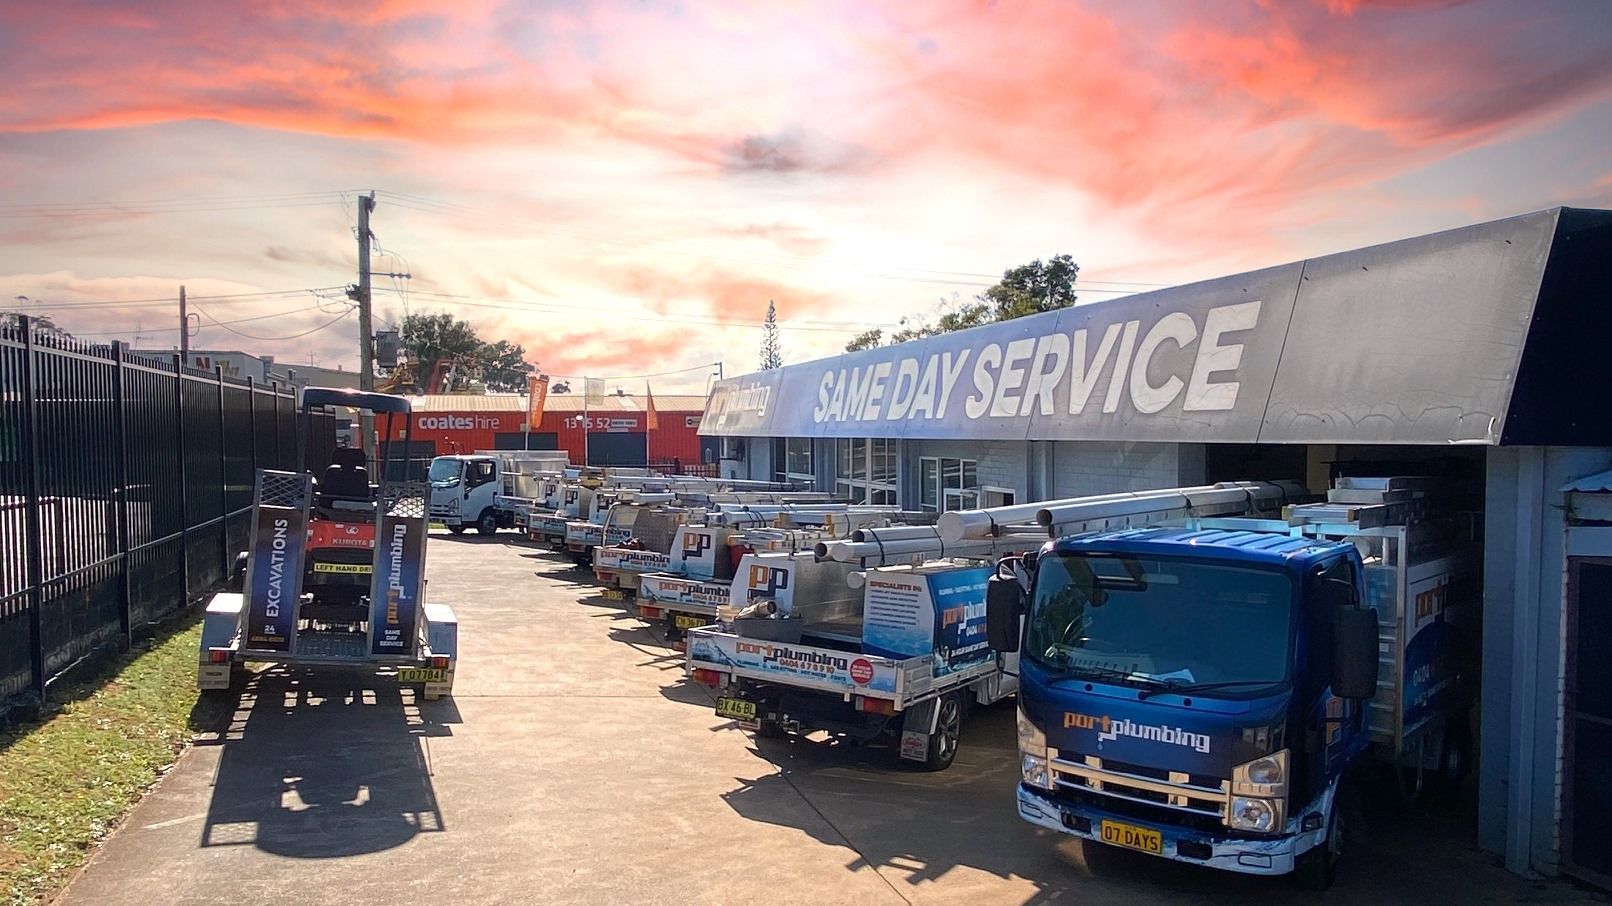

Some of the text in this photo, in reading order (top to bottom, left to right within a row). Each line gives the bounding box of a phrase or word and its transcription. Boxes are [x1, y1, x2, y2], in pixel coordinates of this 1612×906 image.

[813, 300, 1262, 424] SAME DAY SERVICE
[563, 417, 577, 429] 13
[596, 417, 610, 429] 52
[332, 538, 367, 546] KUBOTA
[266, 519, 288, 617] EXCAVATIONS
[1125, 830, 1158, 850] DAYS
